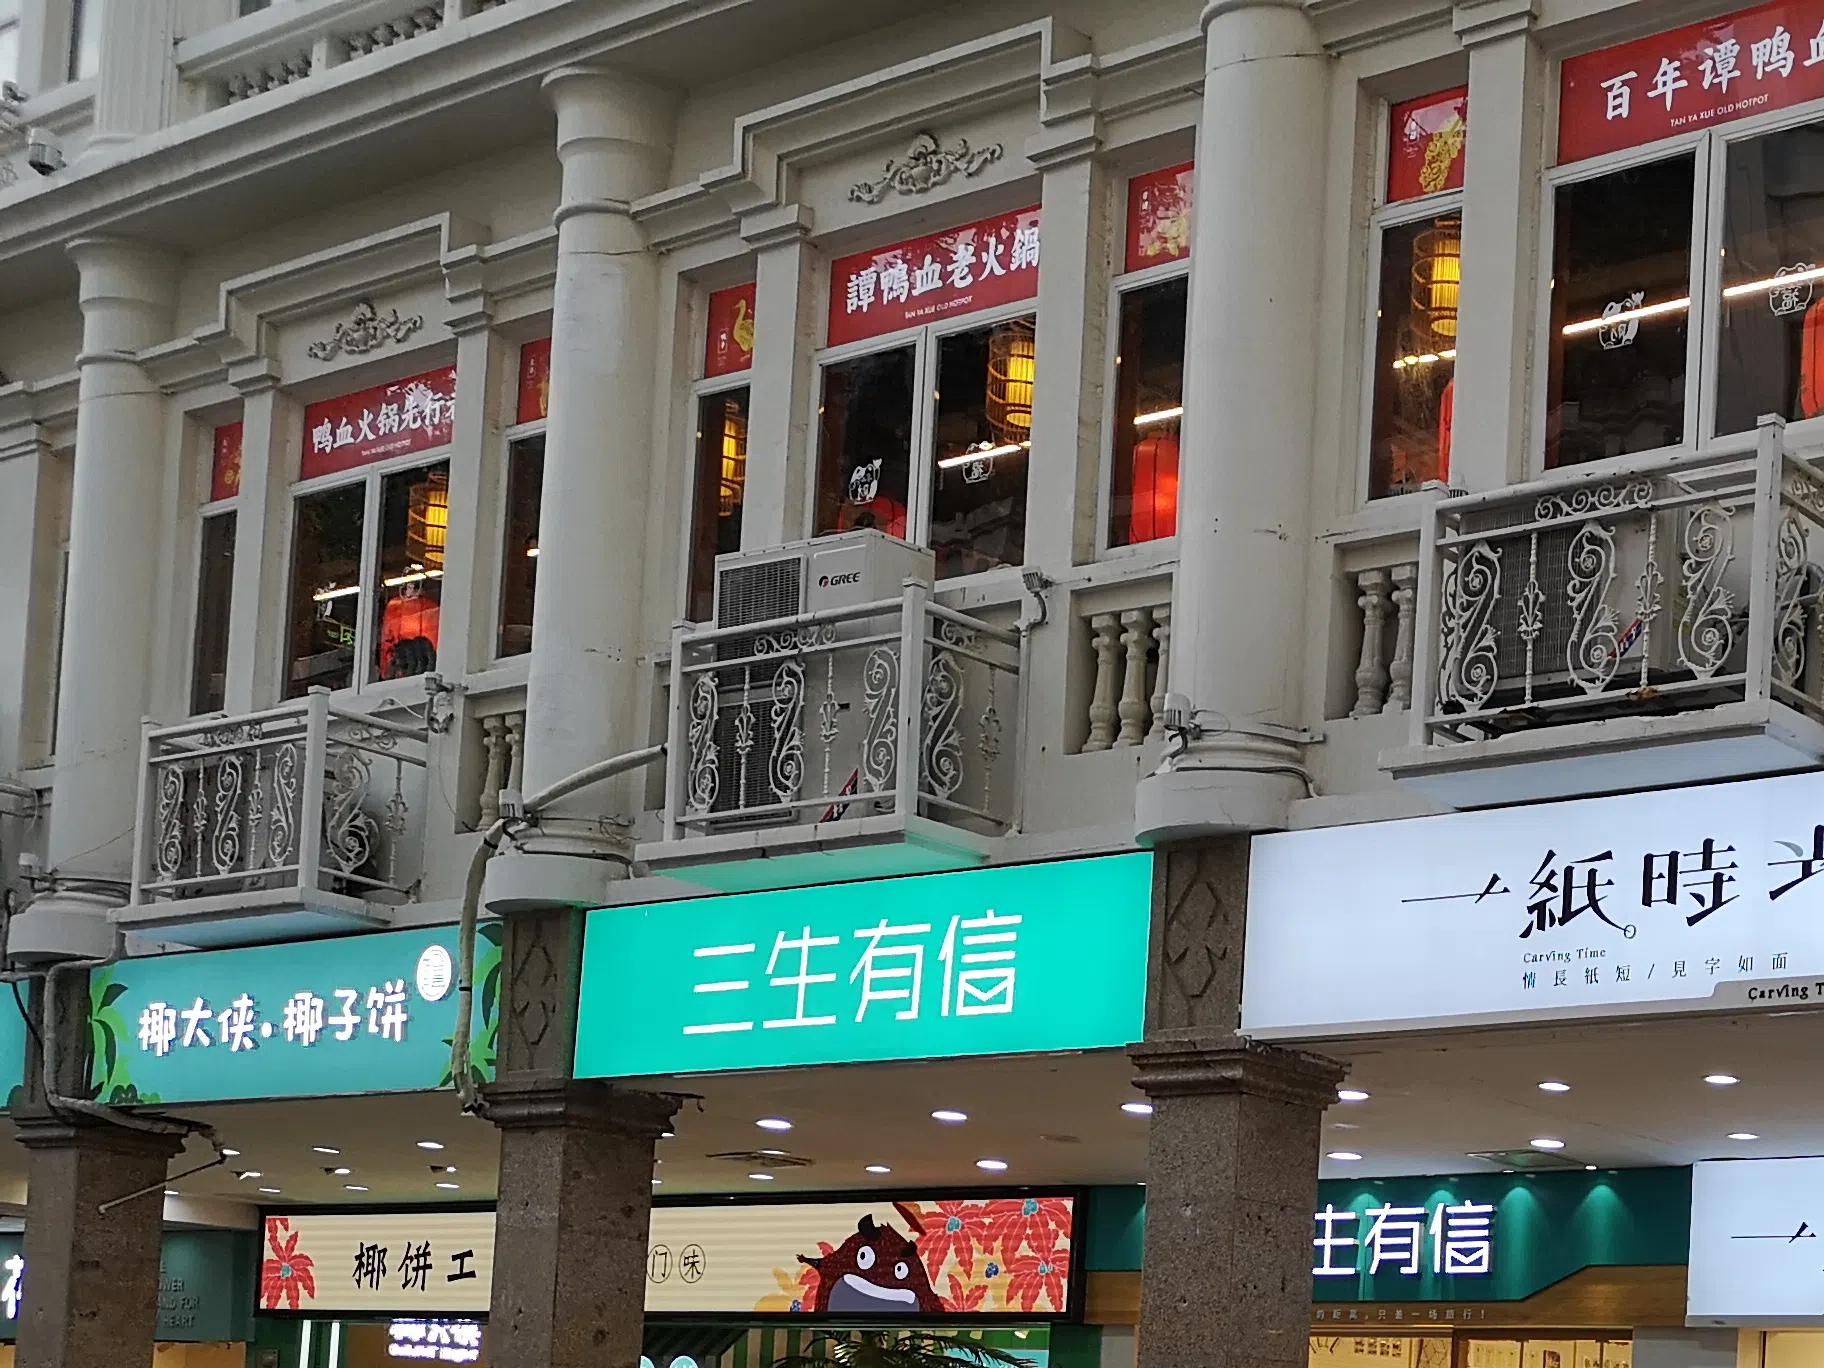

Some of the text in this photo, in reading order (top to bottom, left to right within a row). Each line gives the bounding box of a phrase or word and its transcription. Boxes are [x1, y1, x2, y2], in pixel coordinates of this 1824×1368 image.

[1670, 116, 1686, 127] TAN
[1688, 114, 1698, 123] YA
[1717, 104, 1734, 117] OLD
[1735, 93, 1769, 111] HOTPOT
[847, 226, 1039, 314] 譚鴨血老火鍋
[830, 571, 861, 587] GREE
[682, 909, 1022, 1035] 三生有信
[1523, 947, 1607, 964] Carving Time
[1748, 984, 1809, 1004] Carving
[352, 1240, 477, 1291] 椰饼工
